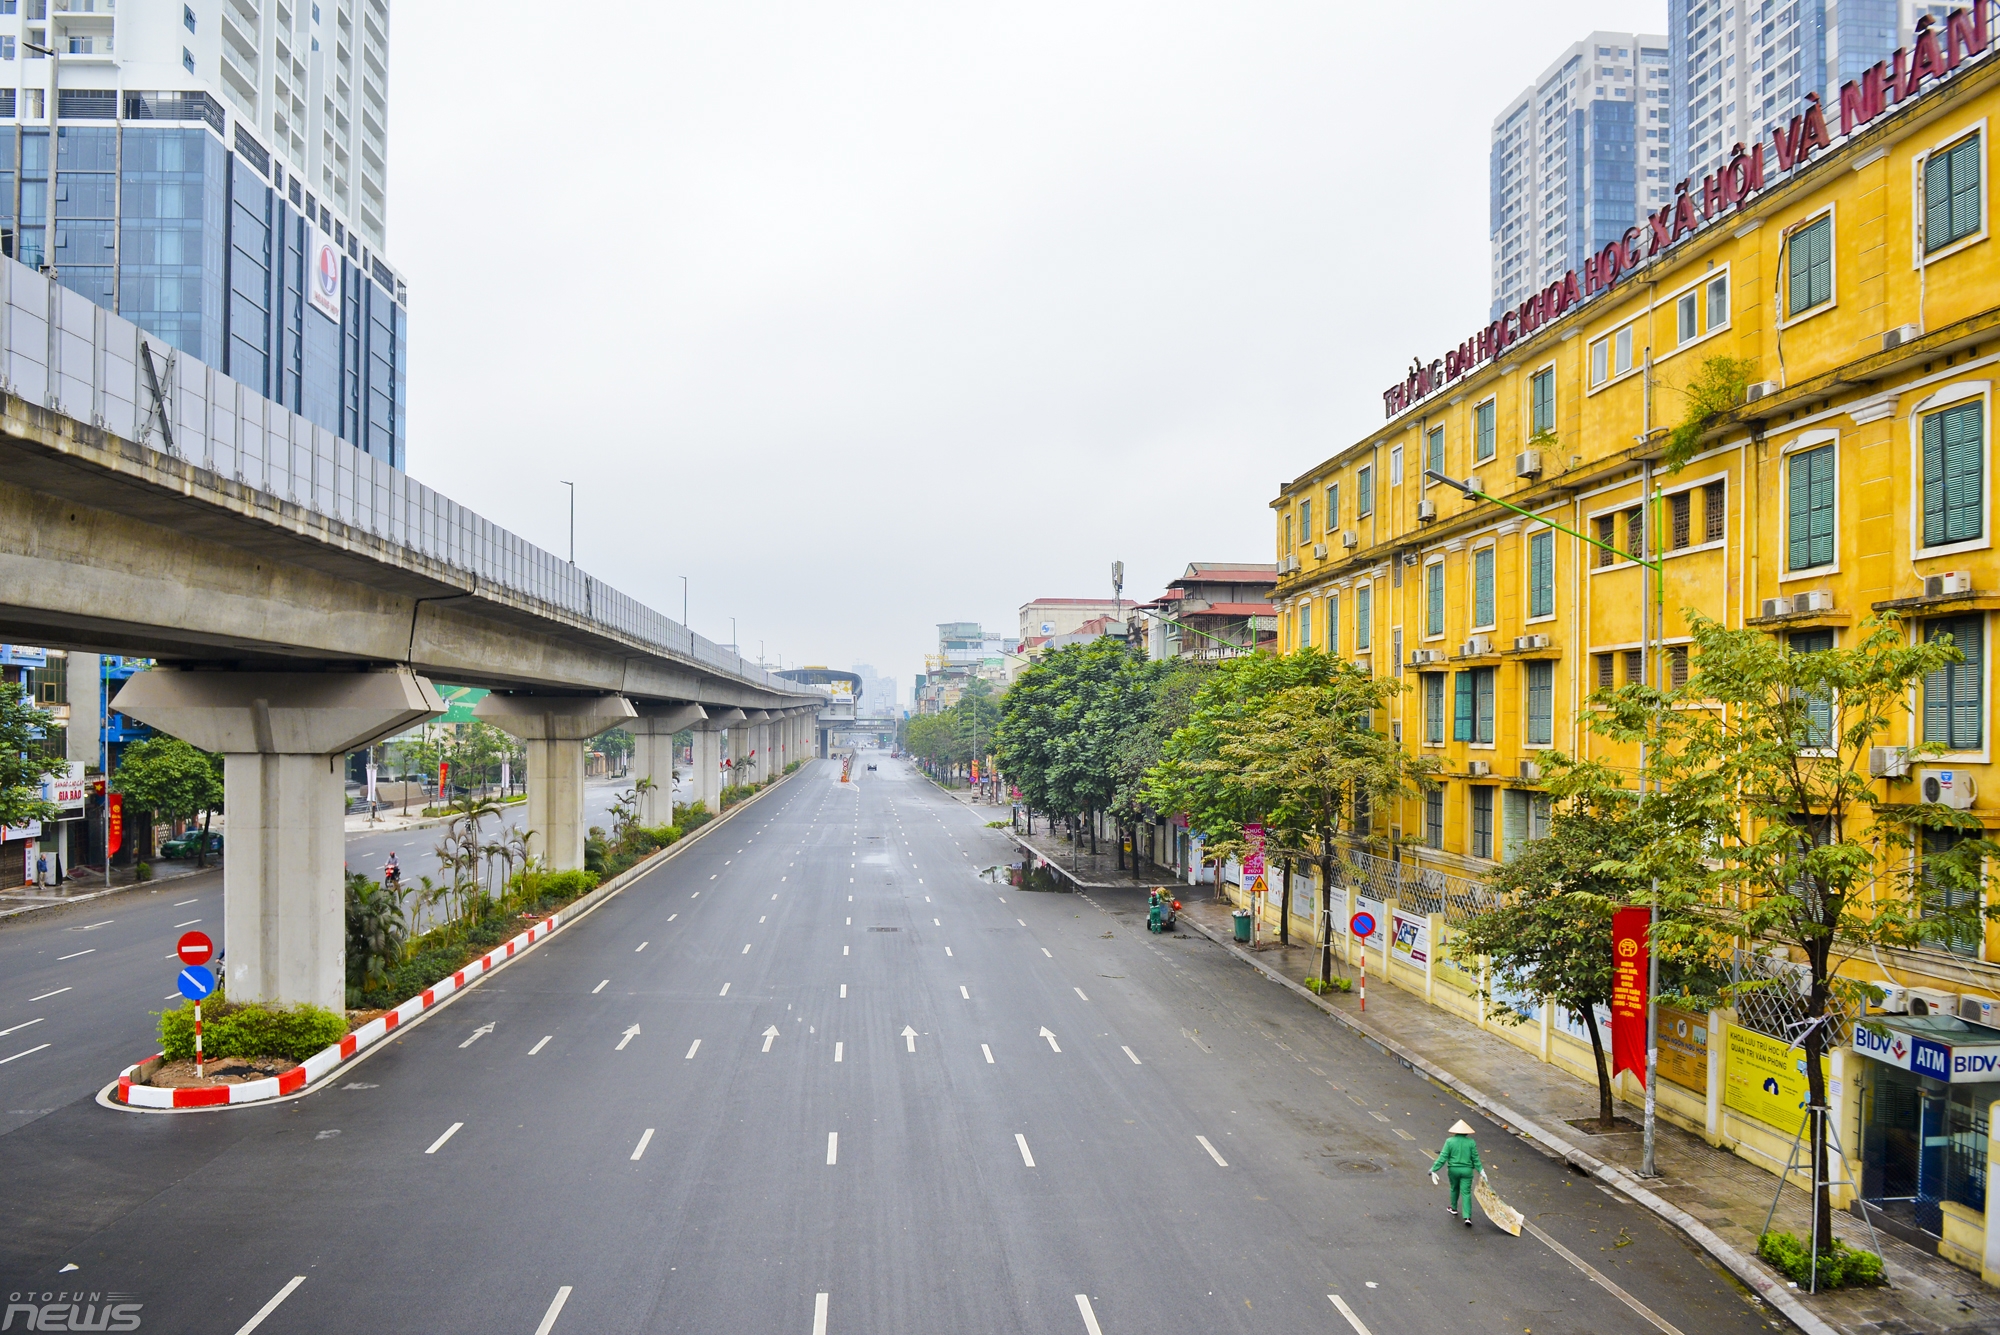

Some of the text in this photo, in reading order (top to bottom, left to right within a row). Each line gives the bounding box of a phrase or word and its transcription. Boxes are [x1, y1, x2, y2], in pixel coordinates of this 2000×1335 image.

[1383, 0, 1988, 419] TRƯỜNG ĐẠI HỌC KHOA HỌC XÃ HỘI VÀ NHÂN
[58, 790, 69, 801] GIA
[1730, 1031, 1744, 1042] KHOA
[1768, 1046, 1780, 1056] HỌC
[1856, 1027, 1945, 1073] BIDV ATM
[1746, 1049, 1755, 1060] TRỊ
[1768, 1057, 1787, 1070] PHÒNG
[1954, 1055, 1998, 1073] BIDV
